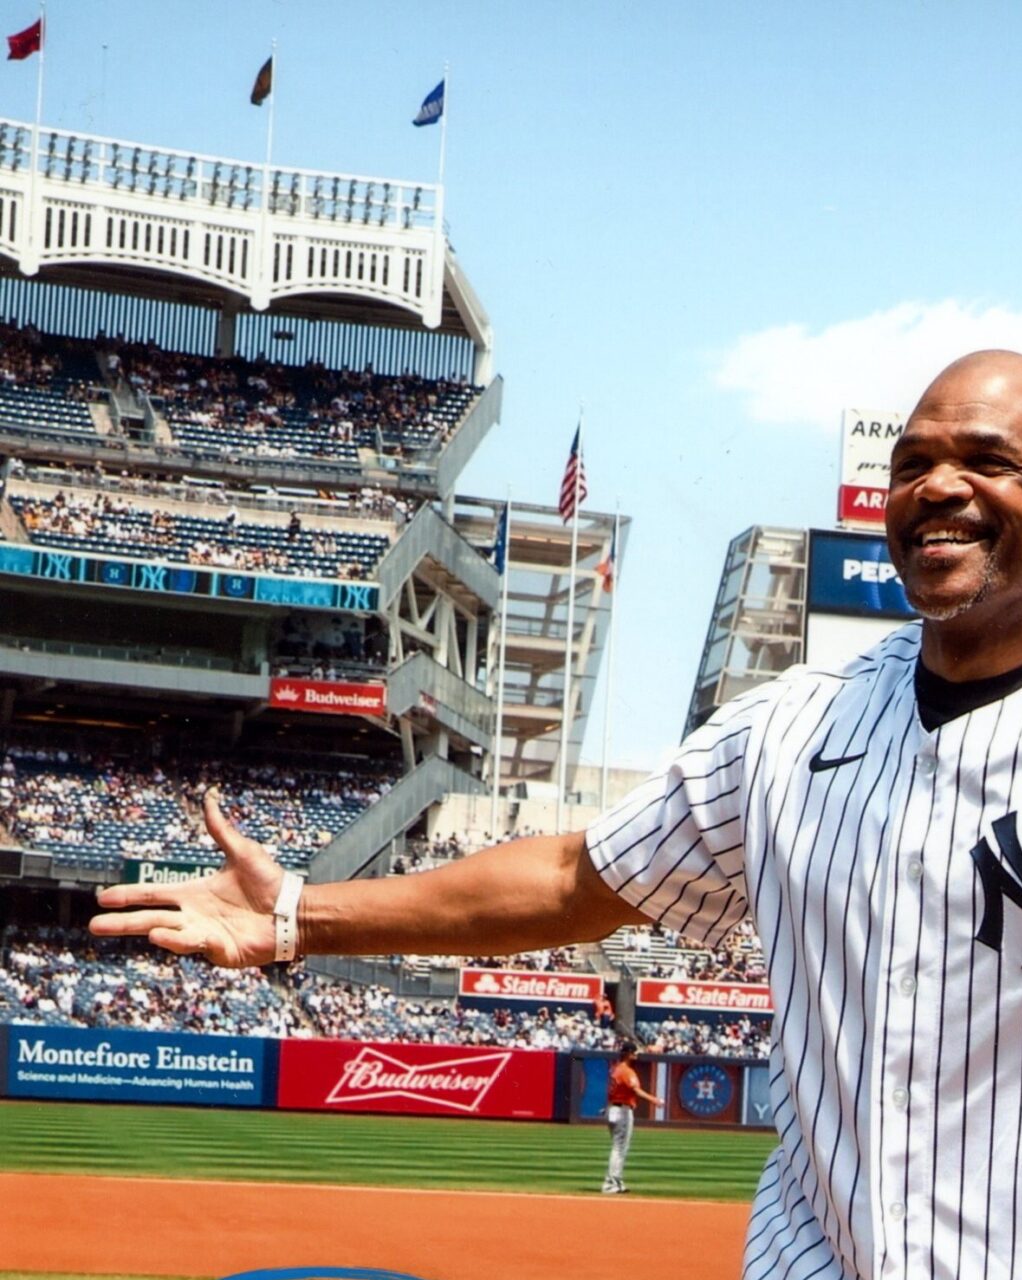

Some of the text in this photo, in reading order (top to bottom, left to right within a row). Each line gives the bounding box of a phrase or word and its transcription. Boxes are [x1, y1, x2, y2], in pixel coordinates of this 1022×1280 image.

[852, 490, 889, 509] AR
[843, 559, 905, 585] PEP
[304, 688, 381, 708] Budweiser
[17, 1039, 254, 1073] Montefiore Einstein
[17, 1070, 55, 1083] Science
[57, 1072, 76, 1083] and
[184, 1078, 219, 1089] Human
[221, 1078, 254, 1091] Health
[344, 1059, 493, 1093] Budweiser
